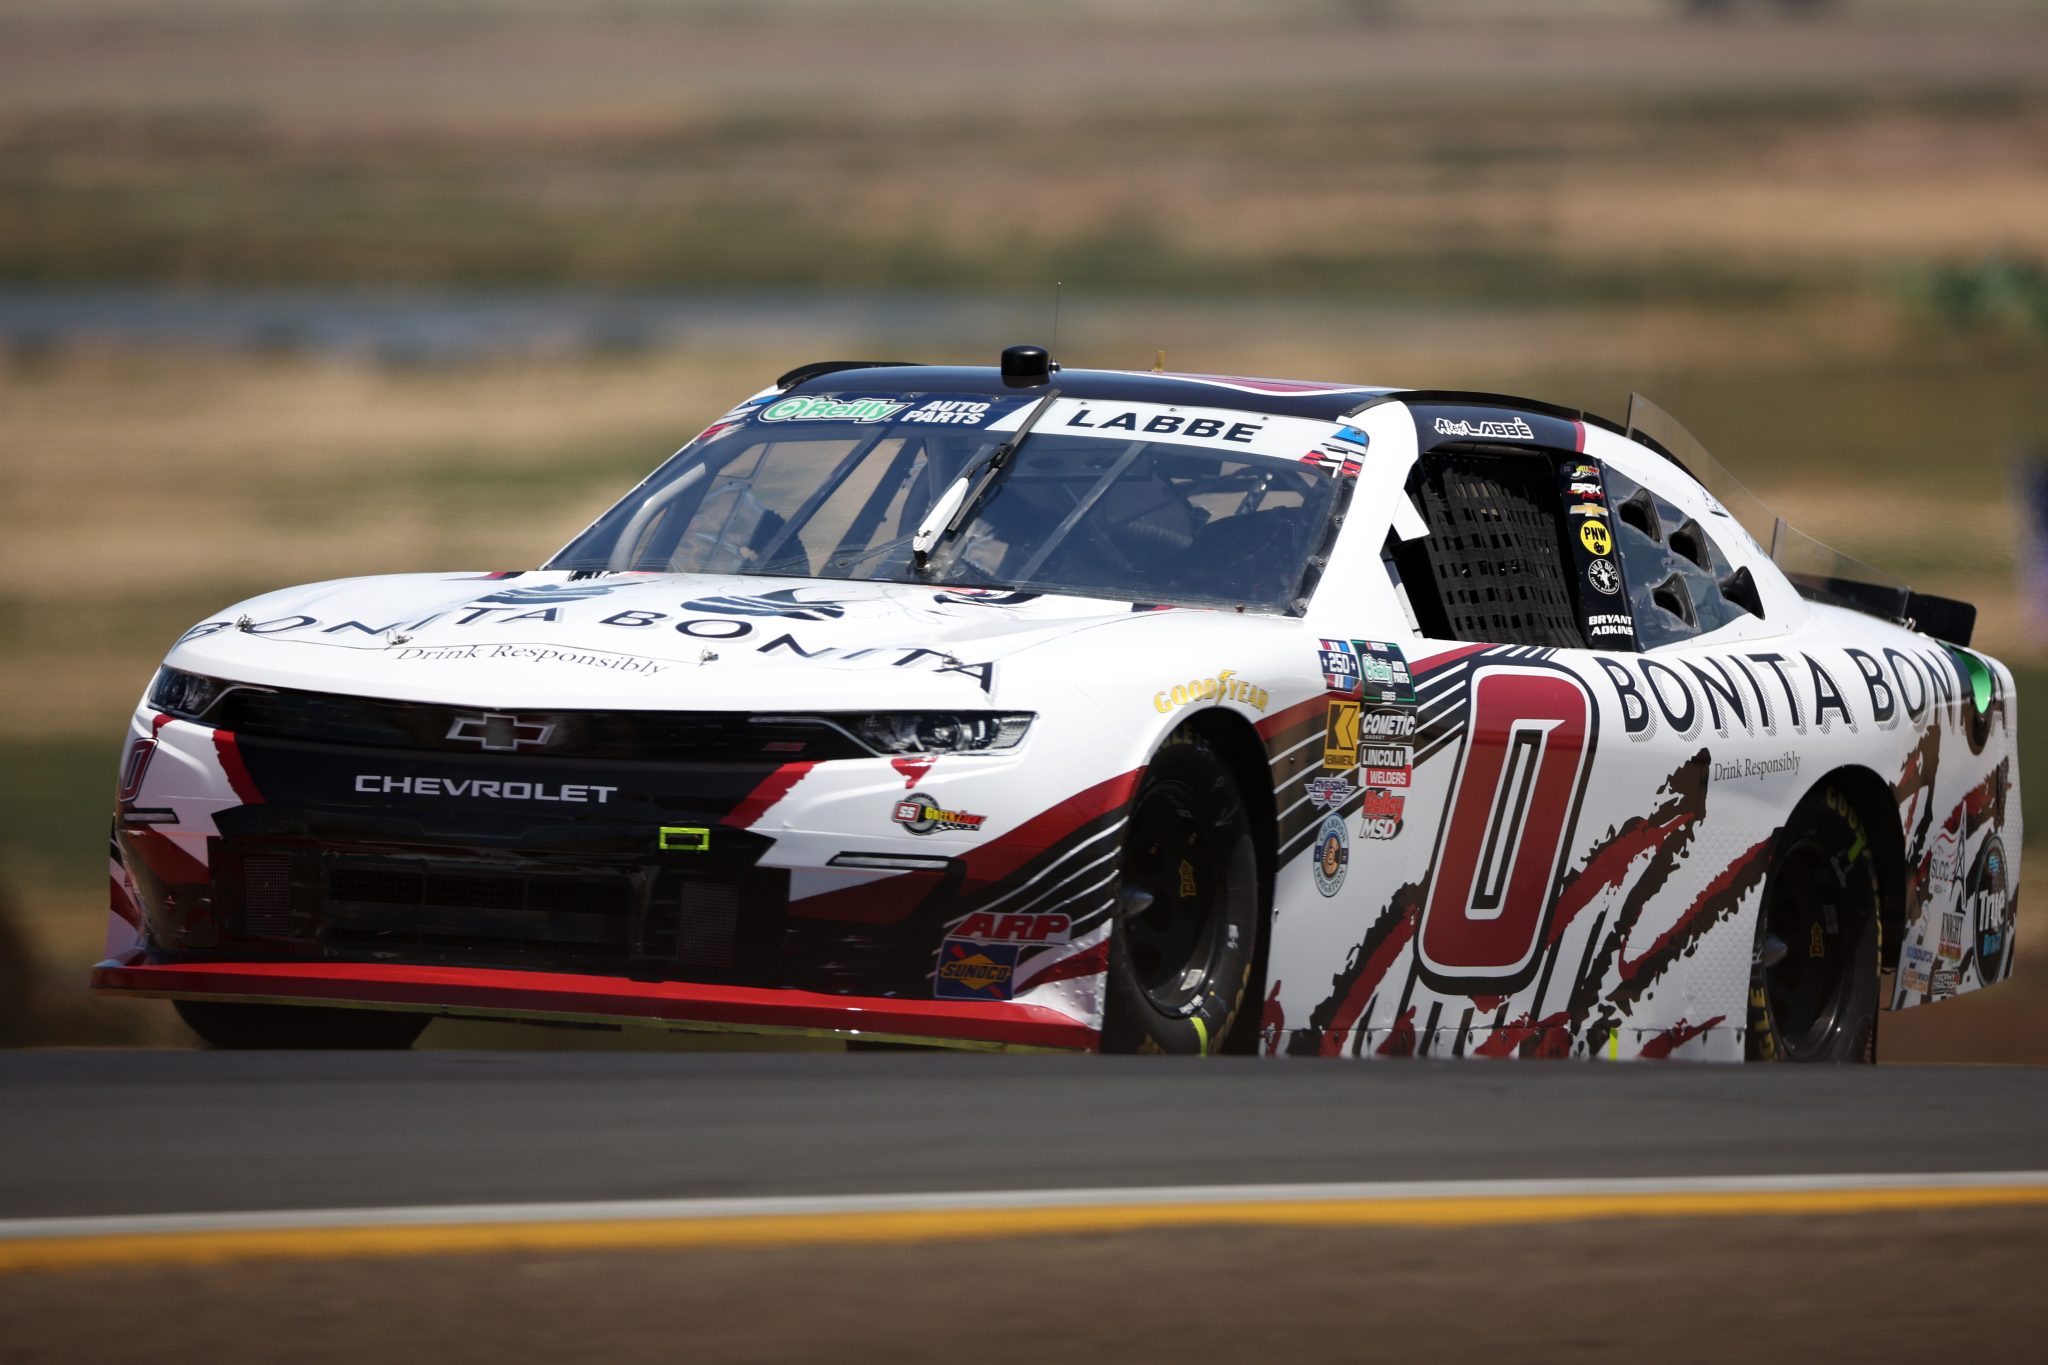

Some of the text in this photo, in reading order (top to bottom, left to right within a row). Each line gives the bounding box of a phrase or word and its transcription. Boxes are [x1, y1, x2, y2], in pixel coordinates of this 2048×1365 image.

[901, 411, 984, 424] PARTS
[920, 401, 990, 413] AUTO
[1066, 409, 1263, 443] LABBE
[1584, 527, 1607, 541] PNW
[1588, 614, 1632, 626] BRYANT
[1591, 625, 1634, 636] ADKINS
[395, 645, 670, 677] Drink Responsibly
[599, 609, 993, 695] BONITA
[1328, 652, 1351, 674] 250
[1153, 670, 1269, 713] GOODYEAR
[1592, 651, 1854, 738] BONITA
[1362, 713, 1416, 736] COMETIC
[1362, 749, 1404, 767] LINCOLN
[1713, 750, 1801, 782] Drink Responsibly
[1370, 770, 1407, 785] WELDERS
[355, 775, 618, 804] CHEVROLET
[1359, 818, 1398, 840] MSD
[1416, 664, 1596, 985] 0
[1979, 890, 2006, 932] True
[952, 912, 1070, 941] ARP
[943, 962, 1009, 982] SUNOCO
